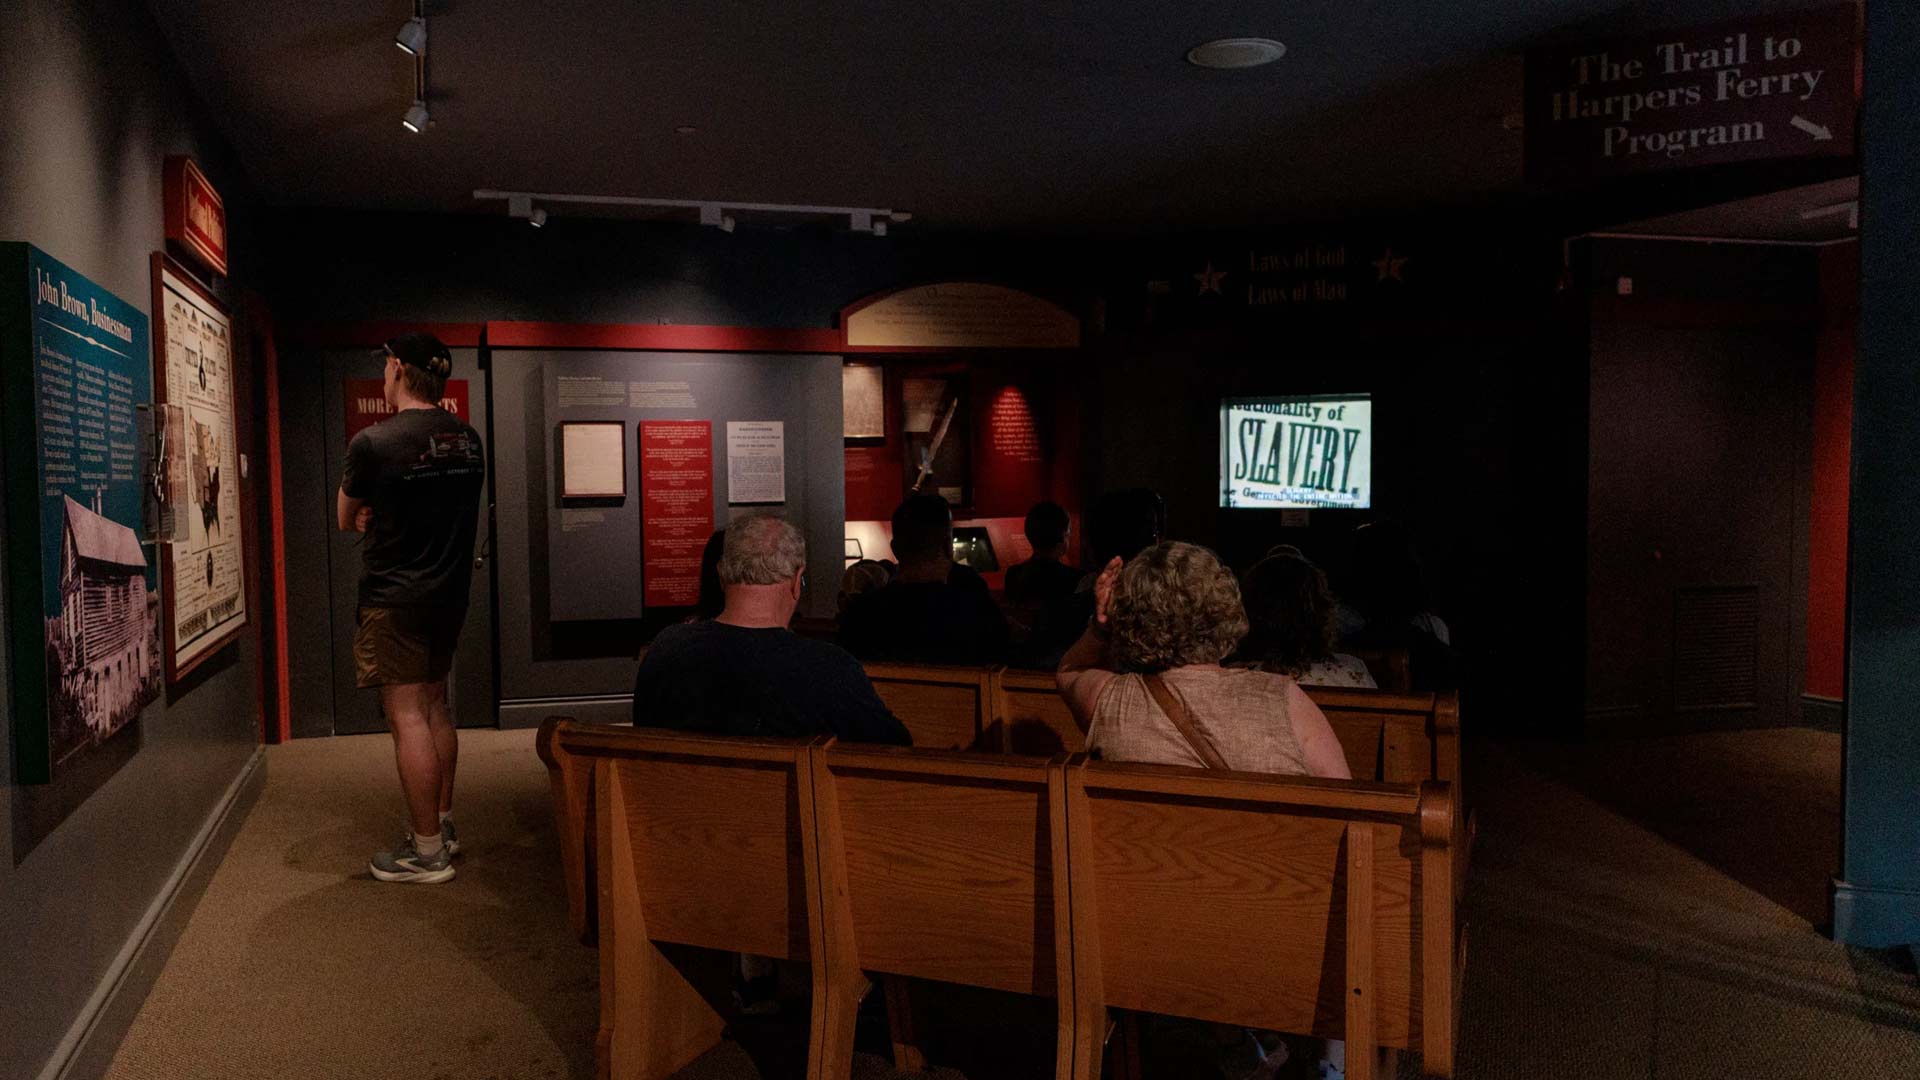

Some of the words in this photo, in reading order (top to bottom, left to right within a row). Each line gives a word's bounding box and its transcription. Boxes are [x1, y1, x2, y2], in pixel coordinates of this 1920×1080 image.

[1571, 52, 1644, 85] The
[1656, 32, 1749, 76] Trail
[1763, 36, 1803, 62] to
[1552, 82, 1702, 122] Harpers
[1714, 67, 1825, 102] Ferry
[1602, 120, 1765, 159] Program
[1248, 250, 1290, 271] Laws
[1294, 248, 1310, 270] of
[36, 266, 59, 308] John
[60, 279, 90, 326] Brown,
[90, 296, 133, 344] Businessman
[1247, 281, 1289, 304] Laws
[1292, 279, 1309, 304] of
[1327, 405, 1346, 421] of
